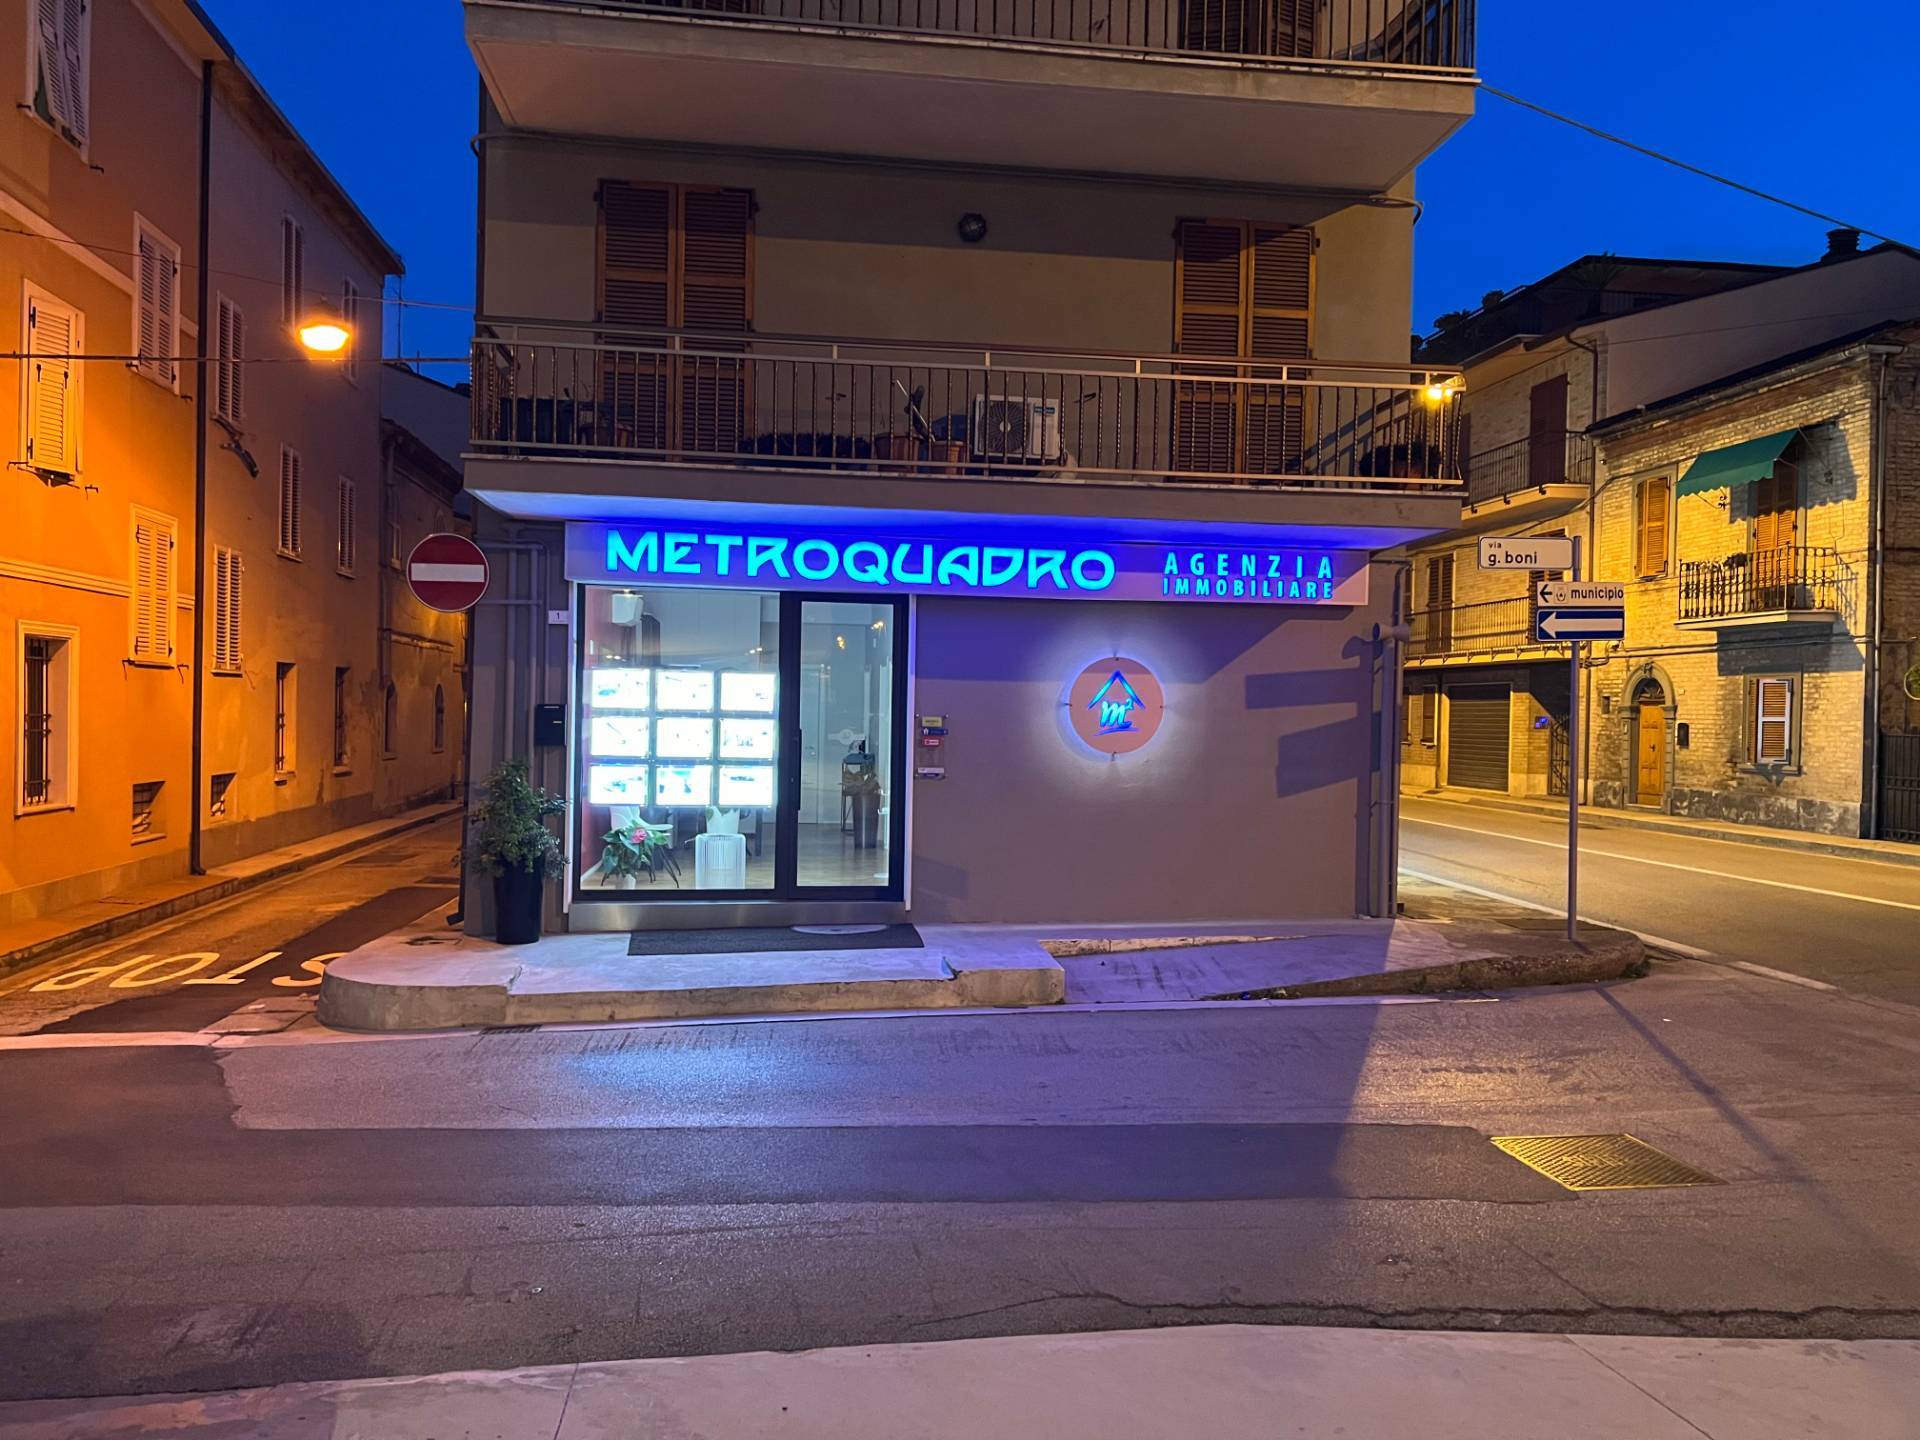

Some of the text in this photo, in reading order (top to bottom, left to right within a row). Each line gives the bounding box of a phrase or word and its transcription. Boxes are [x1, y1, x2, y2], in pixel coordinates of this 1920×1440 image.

[606, 529, 1117, 591] METROQUADRO
[1164, 551, 1333, 579] AGENZIA
[1488, 551, 1538, 566] g. boni
[1163, 577, 1333, 600] IMMOBILIARE
[1570, 586, 1625, 601] municipio
